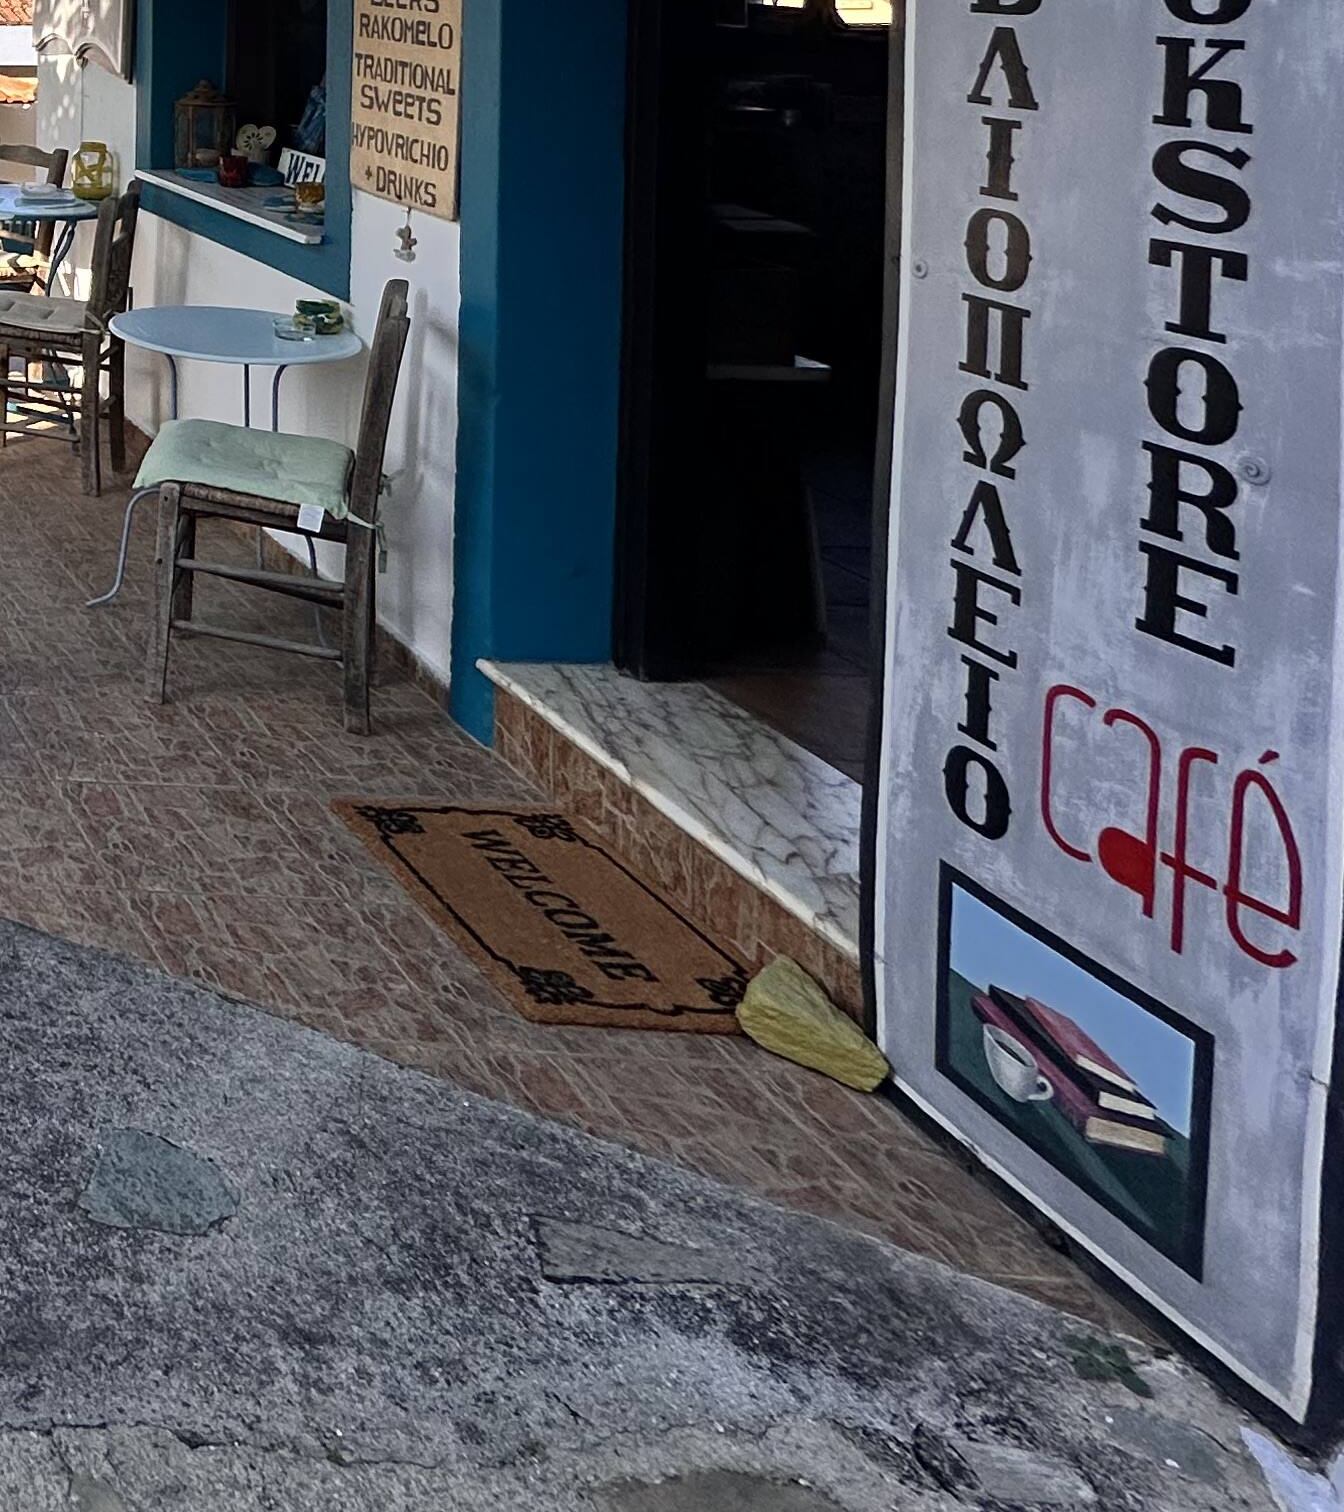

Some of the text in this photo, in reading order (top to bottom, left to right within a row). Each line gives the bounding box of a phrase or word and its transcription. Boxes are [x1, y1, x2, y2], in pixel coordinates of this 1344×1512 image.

[355, 53, 456, 96] TRADITIONAL
[376, 166, 437, 208] DRINKS
[462, 828, 660, 982] WELCOME
